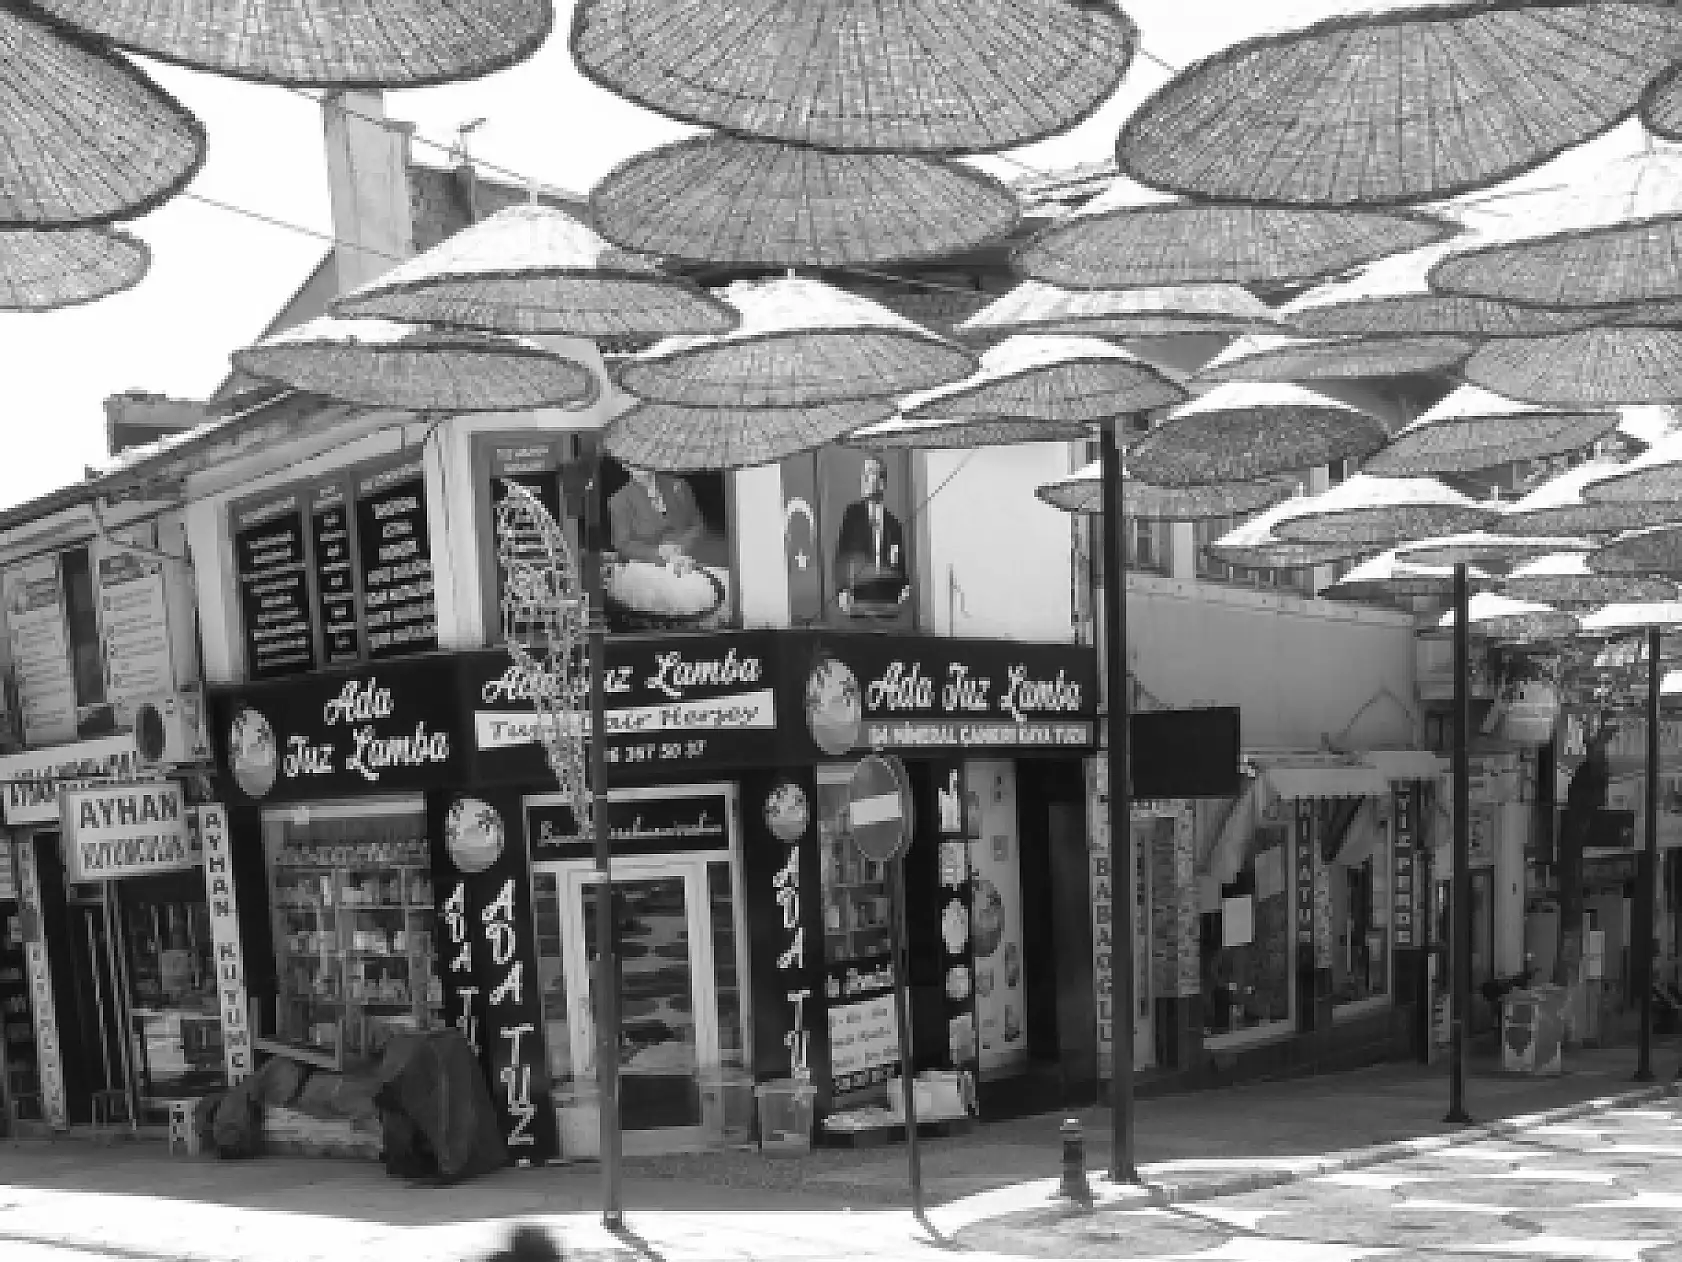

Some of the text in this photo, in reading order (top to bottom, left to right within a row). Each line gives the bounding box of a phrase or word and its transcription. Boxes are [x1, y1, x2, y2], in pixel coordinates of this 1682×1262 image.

[323, 676, 395, 726] Ada
[645, 646, 762, 698] Lamba
[867, 660, 935, 711] Ada
[999, 664, 1082, 723] Lamba
[346, 720, 450, 782] Lamba
[80, 791, 178, 829] AYHAN
[205, 812, 231, 917] AYHAN
[441, 882, 474, 973] ADA
[771, 846, 811, 1079] ADA TU
[481, 877, 538, 1147] ADA TUZ
